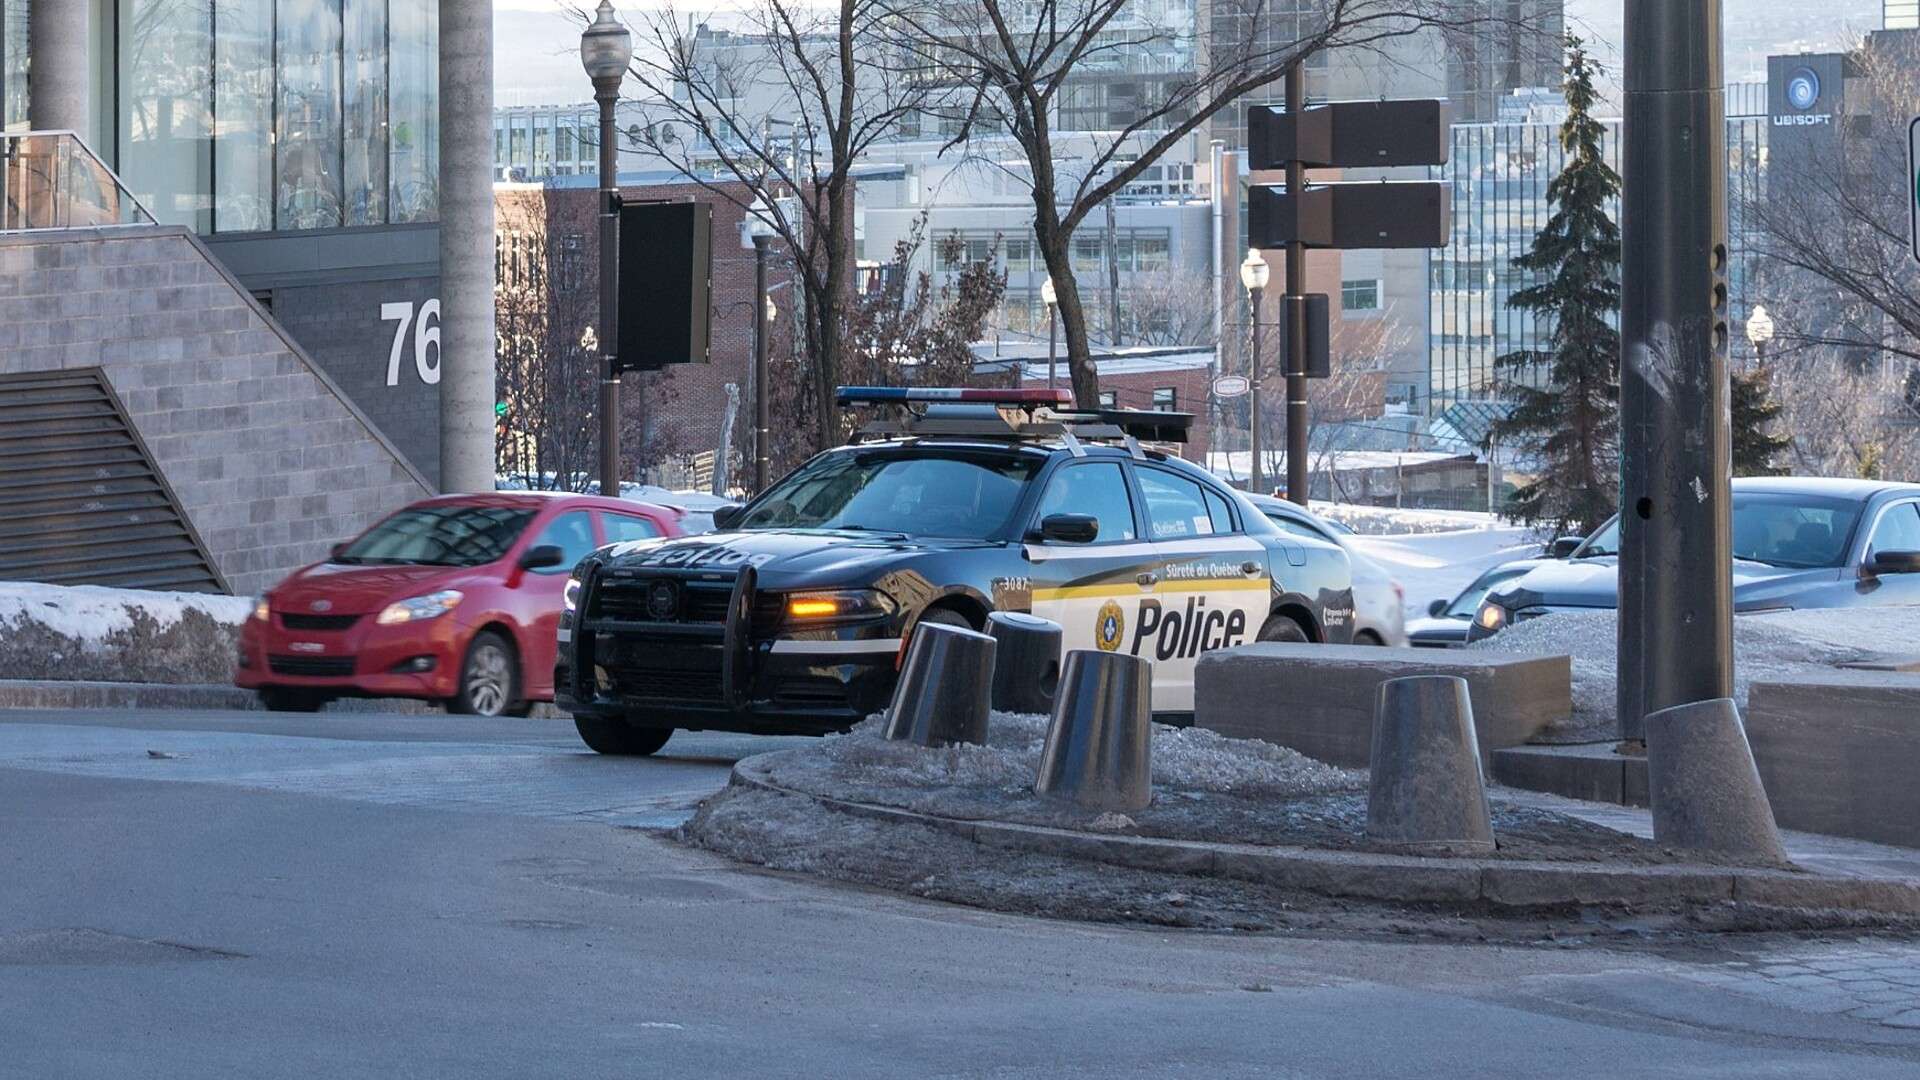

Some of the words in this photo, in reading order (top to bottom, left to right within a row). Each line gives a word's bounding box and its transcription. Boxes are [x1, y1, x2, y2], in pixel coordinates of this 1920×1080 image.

[1773, 114, 1832, 126] UBISOFT
[381, 298, 440, 386] 76
[1166, 562, 1195, 578] Sûreté
[1197, 563, 1208, 577] du
[1210, 560, 1241, 578] Québec
[1004, 577, 1027, 591] 3087
[1131, 595, 1246, 661] Police
